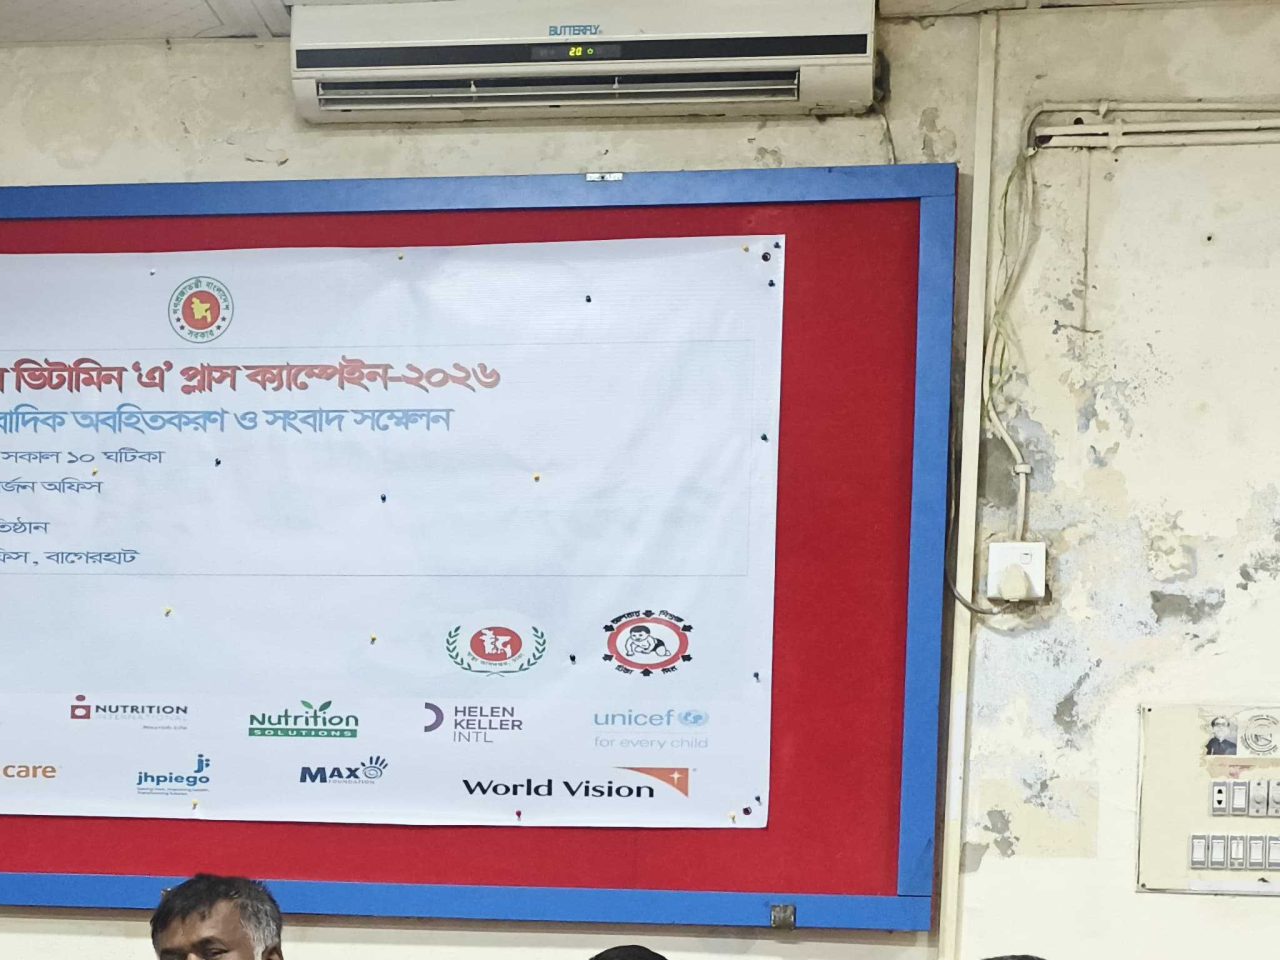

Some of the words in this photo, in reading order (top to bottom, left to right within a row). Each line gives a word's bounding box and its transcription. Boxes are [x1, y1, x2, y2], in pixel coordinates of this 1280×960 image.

[548, 24, 600, 36] BUTTERFLY
[569, 47, 582, 56] 20
[10, 358, 128, 393] ভিটামিন
[180, 362, 241, 395] প্লাস
[72, 403, 228, 435] অবহিতকরণ
[234, 410, 258, 431] ও
[262, 407, 348, 434] সংবাদ
[350, 408, 455, 433] সম্মেলন
[1, 451, 62, 464] সকাল
[67, 451, 95, 464] ১০
[101, 447, 166, 464] ঘটিকা
[41, 477, 104, 494] অফিস
[44, 549, 140, 565] বাগেরহাট
[95, 704, 188, 715] NUTRITION
[249, 708, 359, 727] Nutrition
[454, 706, 515, 718] HELEN
[594, 709, 674, 726] unicef
[254, 729, 352, 737] SOLUTIONS
[454, 719, 523, 731] KELLER
[453, 731, 493, 743] INTL
[594, 736, 617, 748] for
[619, 738, 666, 751] every
[670, 736, 708, 749] child
[2, 764, 56, 779] care
[136, 771, 210, 787] jhpiego
[299, 766, 360, 783] MAX
[462, 778, 553, 797] World
[563, 780, 654, 798] Vision
